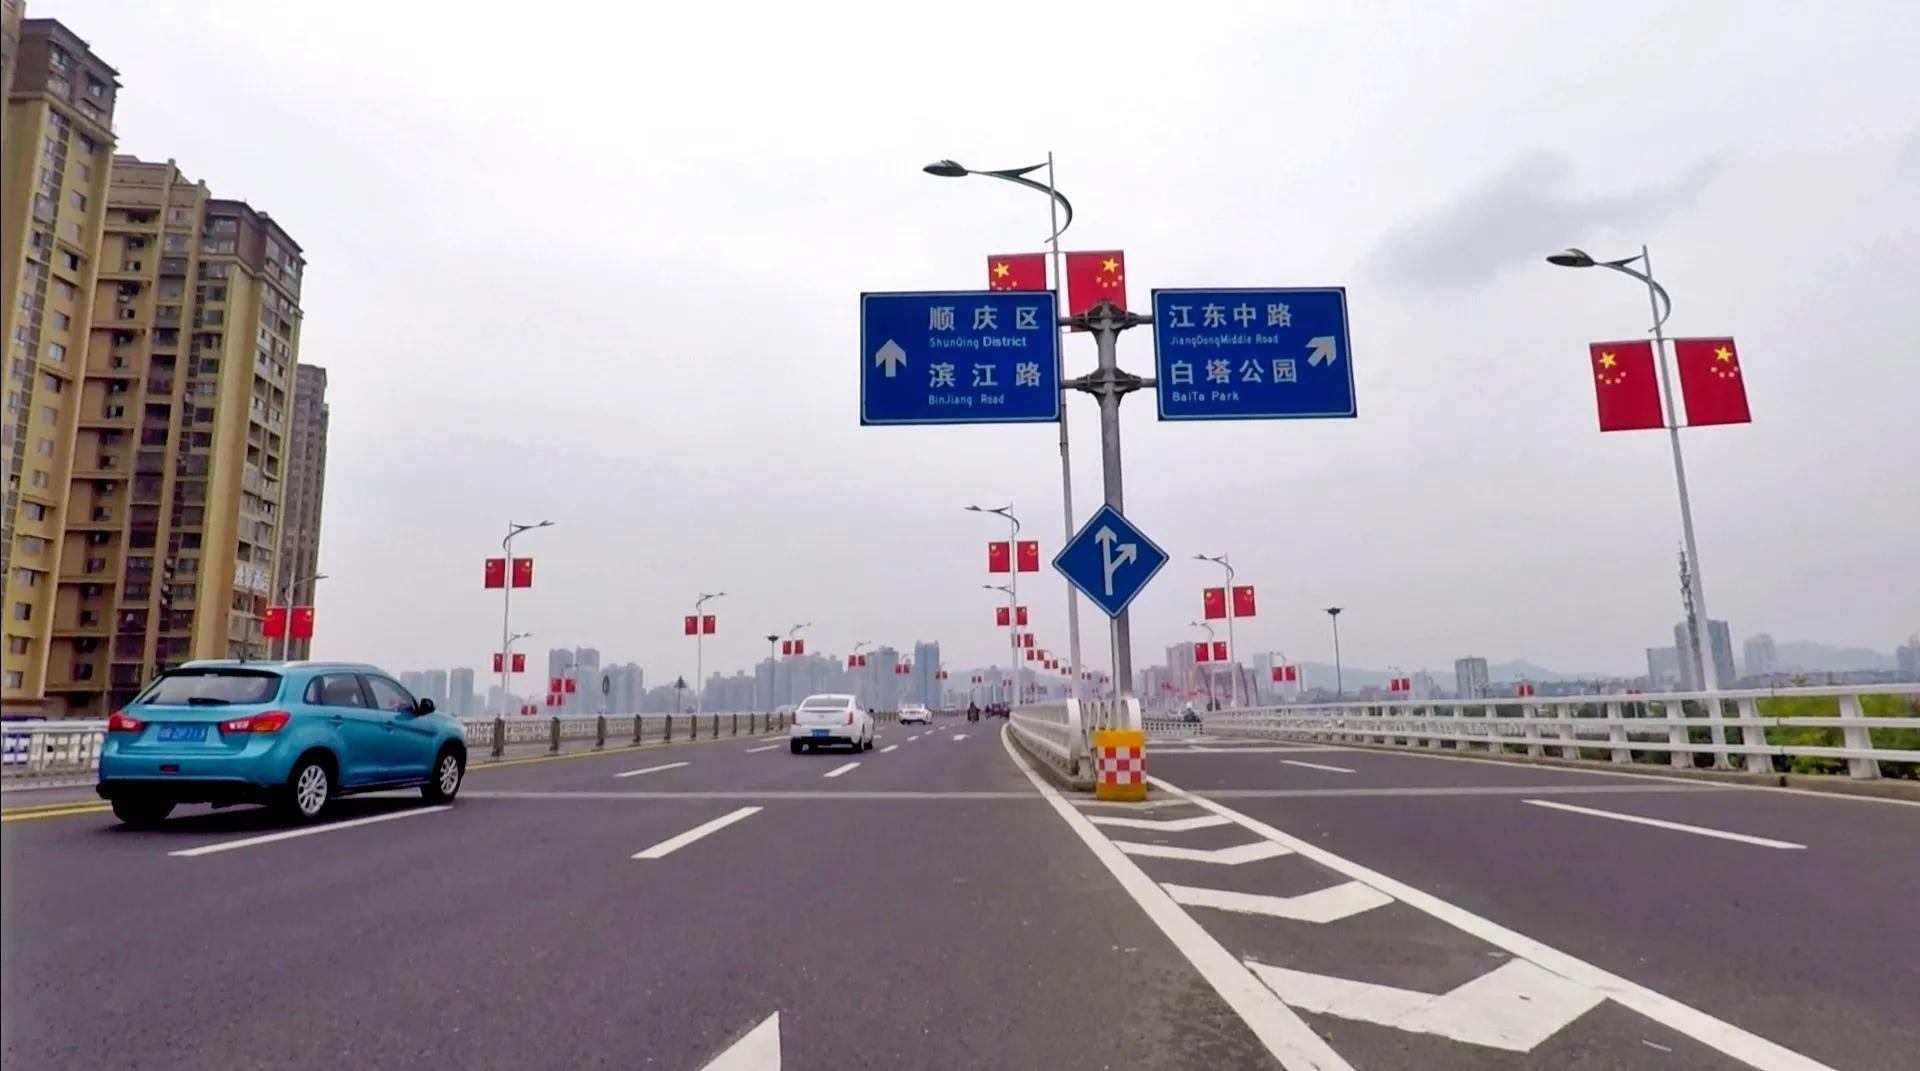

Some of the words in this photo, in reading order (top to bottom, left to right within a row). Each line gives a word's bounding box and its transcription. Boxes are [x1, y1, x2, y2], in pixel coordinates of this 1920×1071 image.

[929, 305, 1039, 331] 顺庆区
[1168, 302, 1293, 328] 江东中路
[929, 337, 979, 350] ShunQing
[982, 336, 1027, 347] District
[1256, 334, 1279, 345] Road
[929, 362, 1041, 388] 滨江路
[1171, 359, 1298, 385] 白塔公园
[928, 395, 972, 407] BinJiang
[981, 394, 1005, 405] Road
[1172, 391, 1205, 402] BaiTa
[1211, 391, 1240, 401] Park
